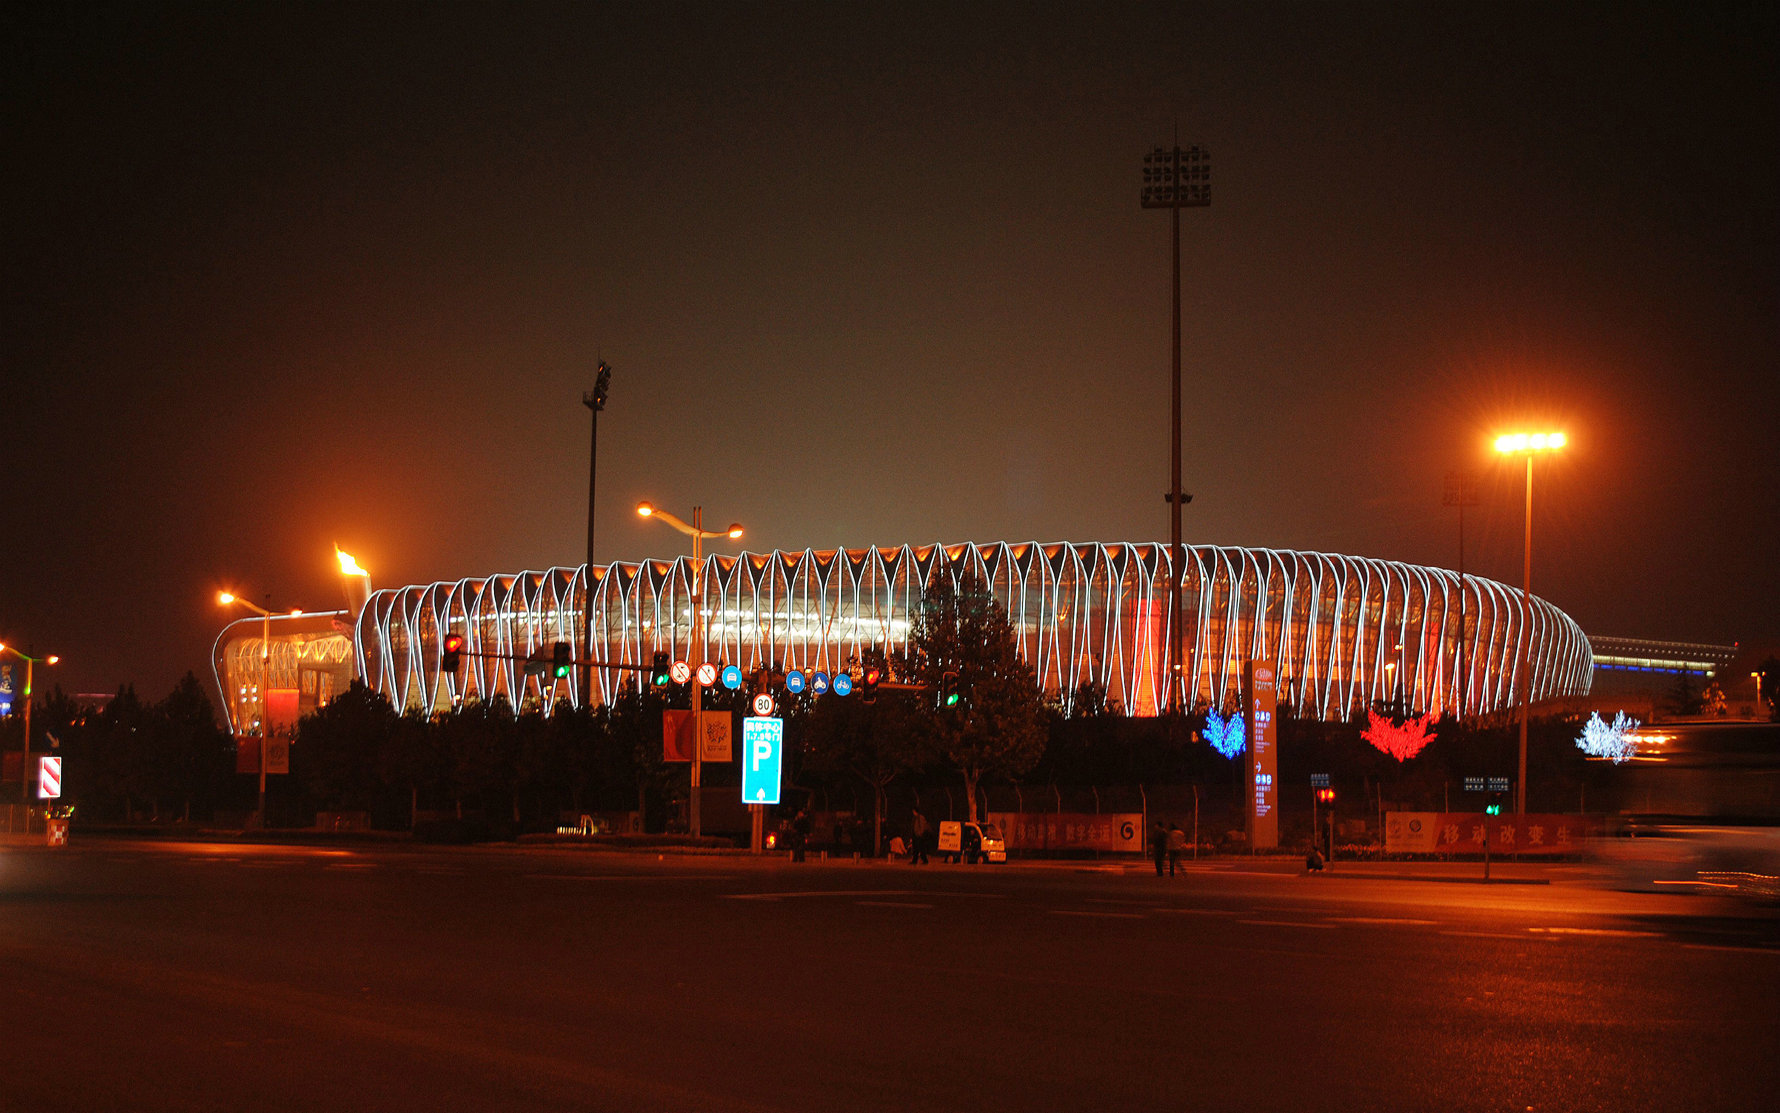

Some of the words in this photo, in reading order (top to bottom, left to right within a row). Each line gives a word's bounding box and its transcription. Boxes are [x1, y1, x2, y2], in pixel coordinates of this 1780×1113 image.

[758, 699, 770, 711] 80
[753, 741, 772, 771] P
[1443, 824, 1598, 846] 移动改变生
